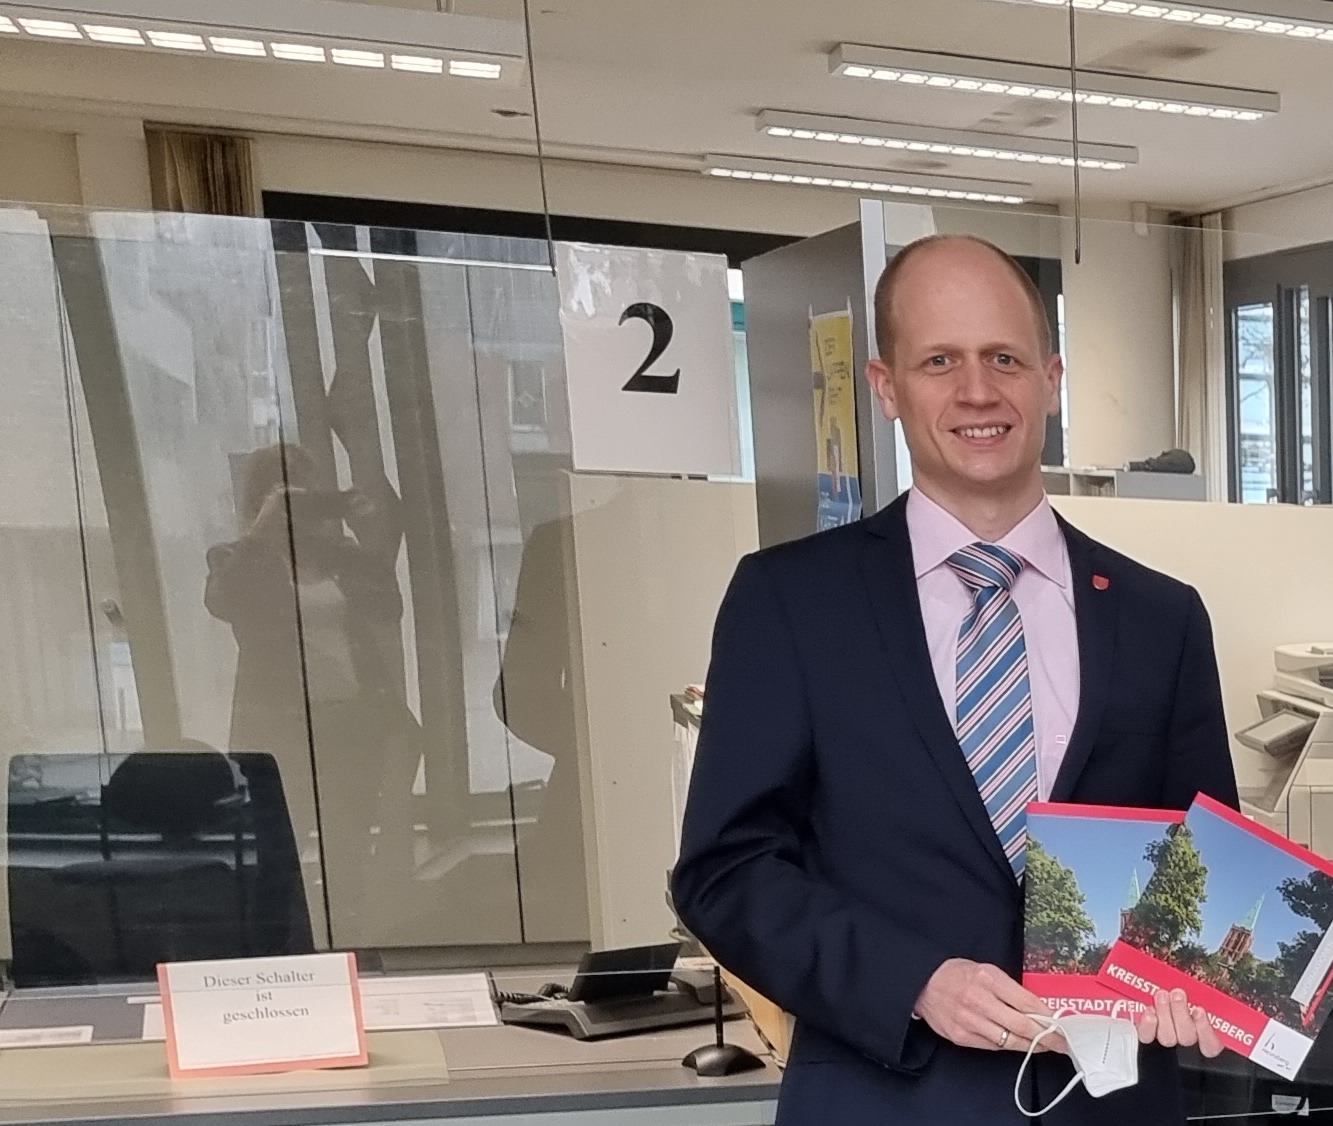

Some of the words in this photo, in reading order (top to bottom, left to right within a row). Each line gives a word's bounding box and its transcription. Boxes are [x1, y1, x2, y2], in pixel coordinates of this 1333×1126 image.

[618, 302, 681, 394] 2
[203, 975, 251, 988] Dieser
[256, 970, 315, 985] Schalter
[256, 990, 273, 1002] ist
[1039, 997, 1114, 1011] EISSTADT
[1106, 963, 1163, 997] KREISST
[1187, 1002, 1255, 1046] HNSBERG
[222, 1006, 309, 1025] geschlossen
